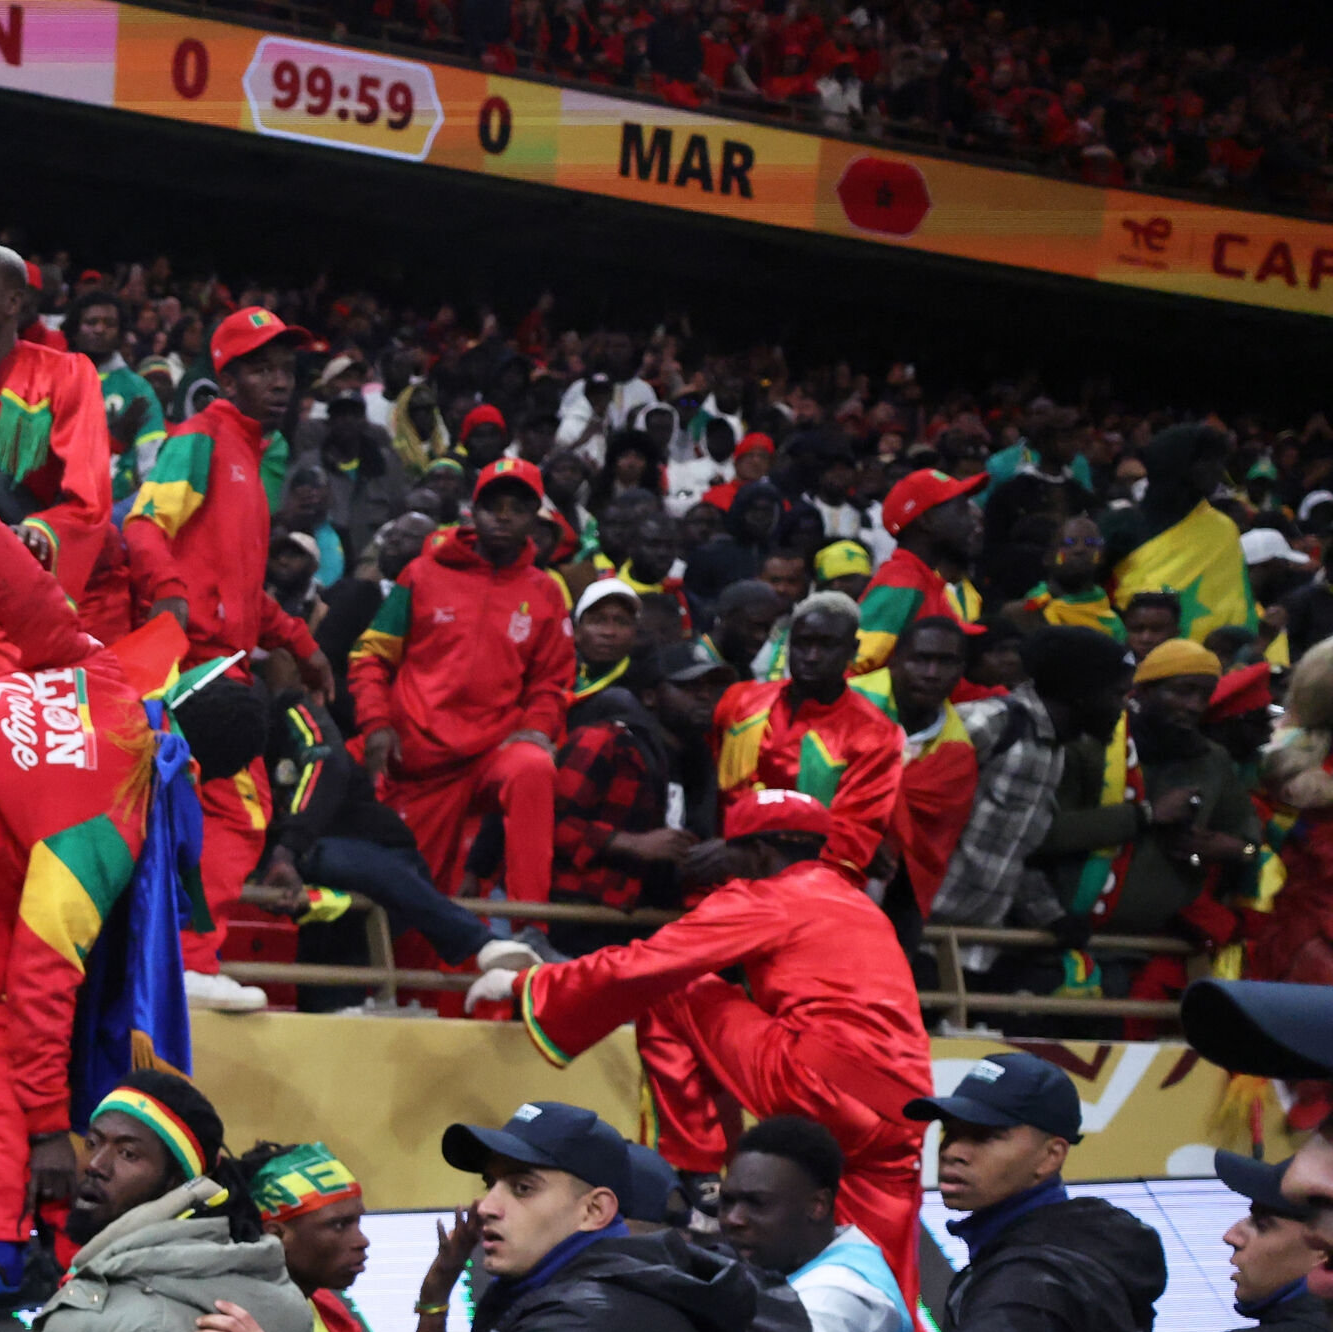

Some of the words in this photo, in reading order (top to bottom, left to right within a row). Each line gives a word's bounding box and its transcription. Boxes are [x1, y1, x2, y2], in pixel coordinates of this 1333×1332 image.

[171, 38, 210, 99] 0
[271, 60, 416, 130] 99:59
[478, 96, 512, 154] 0
[618, 121, 755, 198] MAR
[33, 667, 86, 769] LION
